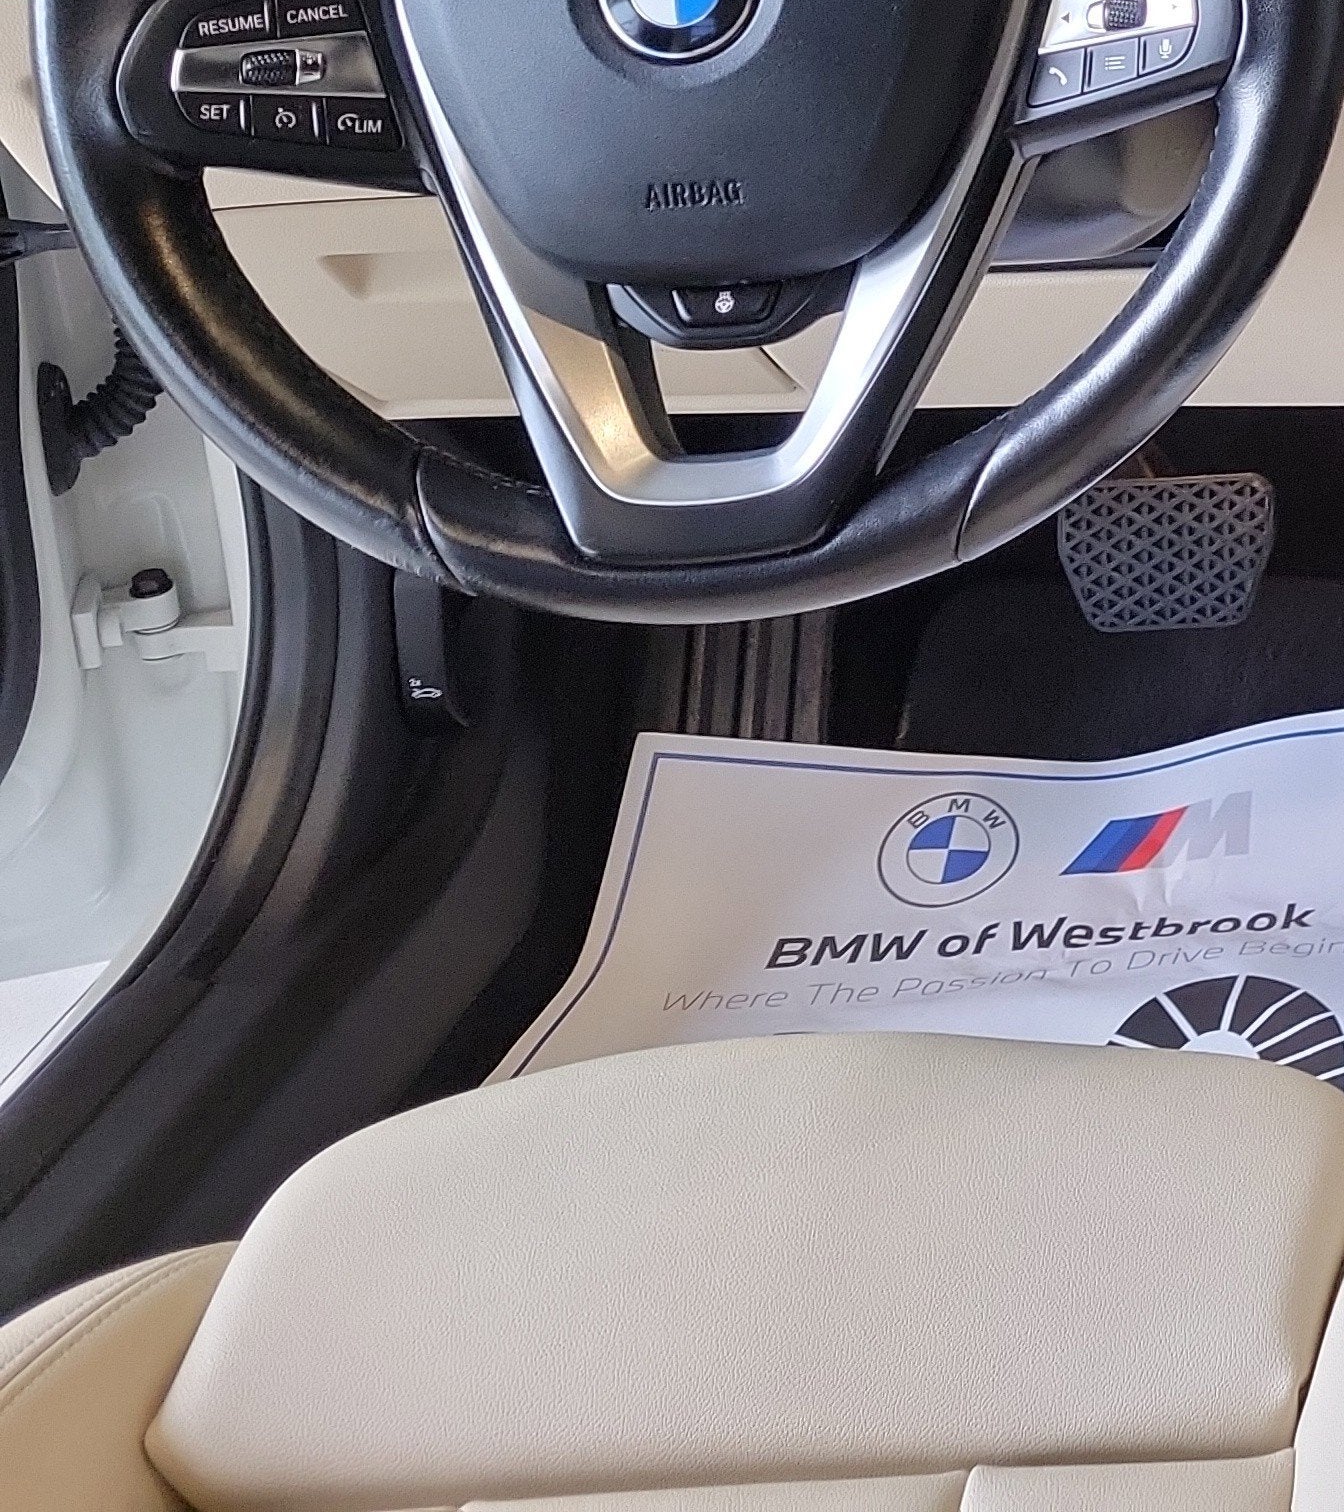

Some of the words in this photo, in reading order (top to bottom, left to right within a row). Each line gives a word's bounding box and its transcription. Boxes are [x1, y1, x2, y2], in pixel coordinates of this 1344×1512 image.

[197, 13, 264, 37] RESUME
[285, 3, 348, 24] CANCEL
[199, 104, 231, 120] SET
[355, 119, 383, 133] LIM
[645, 179, 744, 210] AIRBAG
[907, 797, 1005, 830] BMW
[764, 929, 929, 970] BMW
[936, 922, 1000, 959] of
[1011, 903, 1317, 952] Westbrook
[662, 990, 788, 1013] Where
[808, 983, 879, 1006] The
[892, 969, 1048, 999] Passion
[1069, 958, 1113, 978] To
[1126, 942, 1225, 971] Drive
